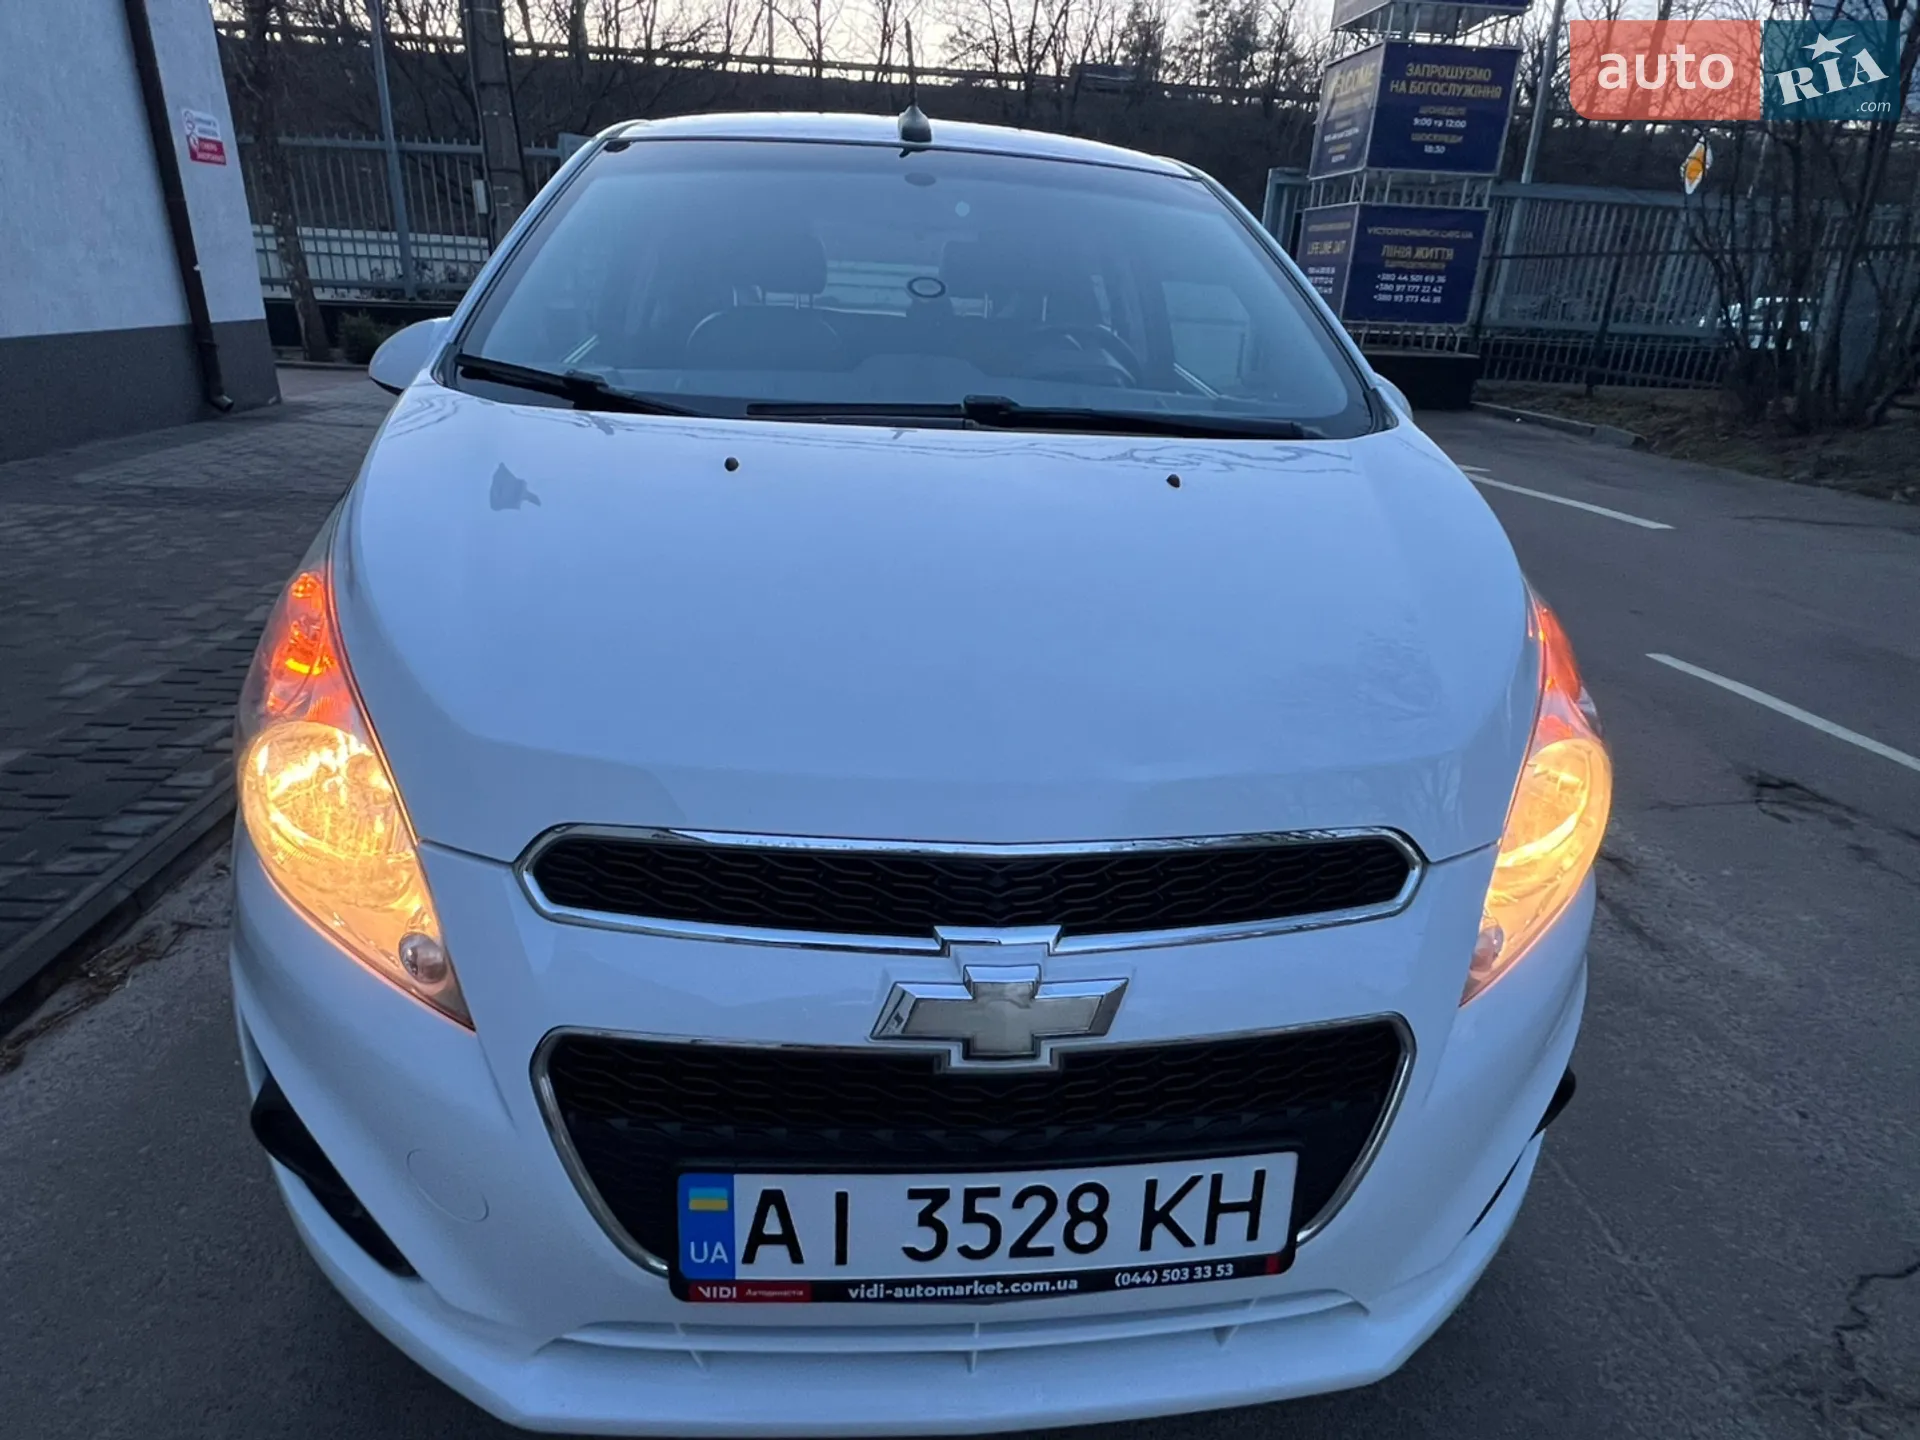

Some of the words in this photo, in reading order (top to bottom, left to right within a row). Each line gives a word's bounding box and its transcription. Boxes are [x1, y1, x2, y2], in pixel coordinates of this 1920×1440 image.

[1406, 63, 1492, 81] ЗАПРОШУЄМО
[1390, 80, 1407, 94] НА
[1409, 81, 1502, 98] БОГОСЛУЖІННЯ
[1413, 117, 1432, 127] 9:00
[1445, 119, 1467, 128] 12:00
[1382, 244, 1412, 258] ЛІНІЯ
[1413, 246, 1454, 260] ЖИТТЯ
[1377, 273, 1396, 281] +380
[1375, 283, 1394, 292] +380
[1373, 294, 1392, 302] +380
[741, 1189, 849, 1265] AI
[901, 1181, 1110, 1262] 3528
[1139, 1168, 1266, 1252] KH
[690, 1241, 729, 1264] UA
[1114, 1269, 1158, 1288] (044)
[1161, 1266, 1190, 1283] 503
[1194, 1265, 1212, 1280] 33
[1215, 1263, 1234, 1278] 53
[697, 1286, 737, 1299] VIDI
[848, 1278, 1078, 1299] vidi-automarket.com.ua
